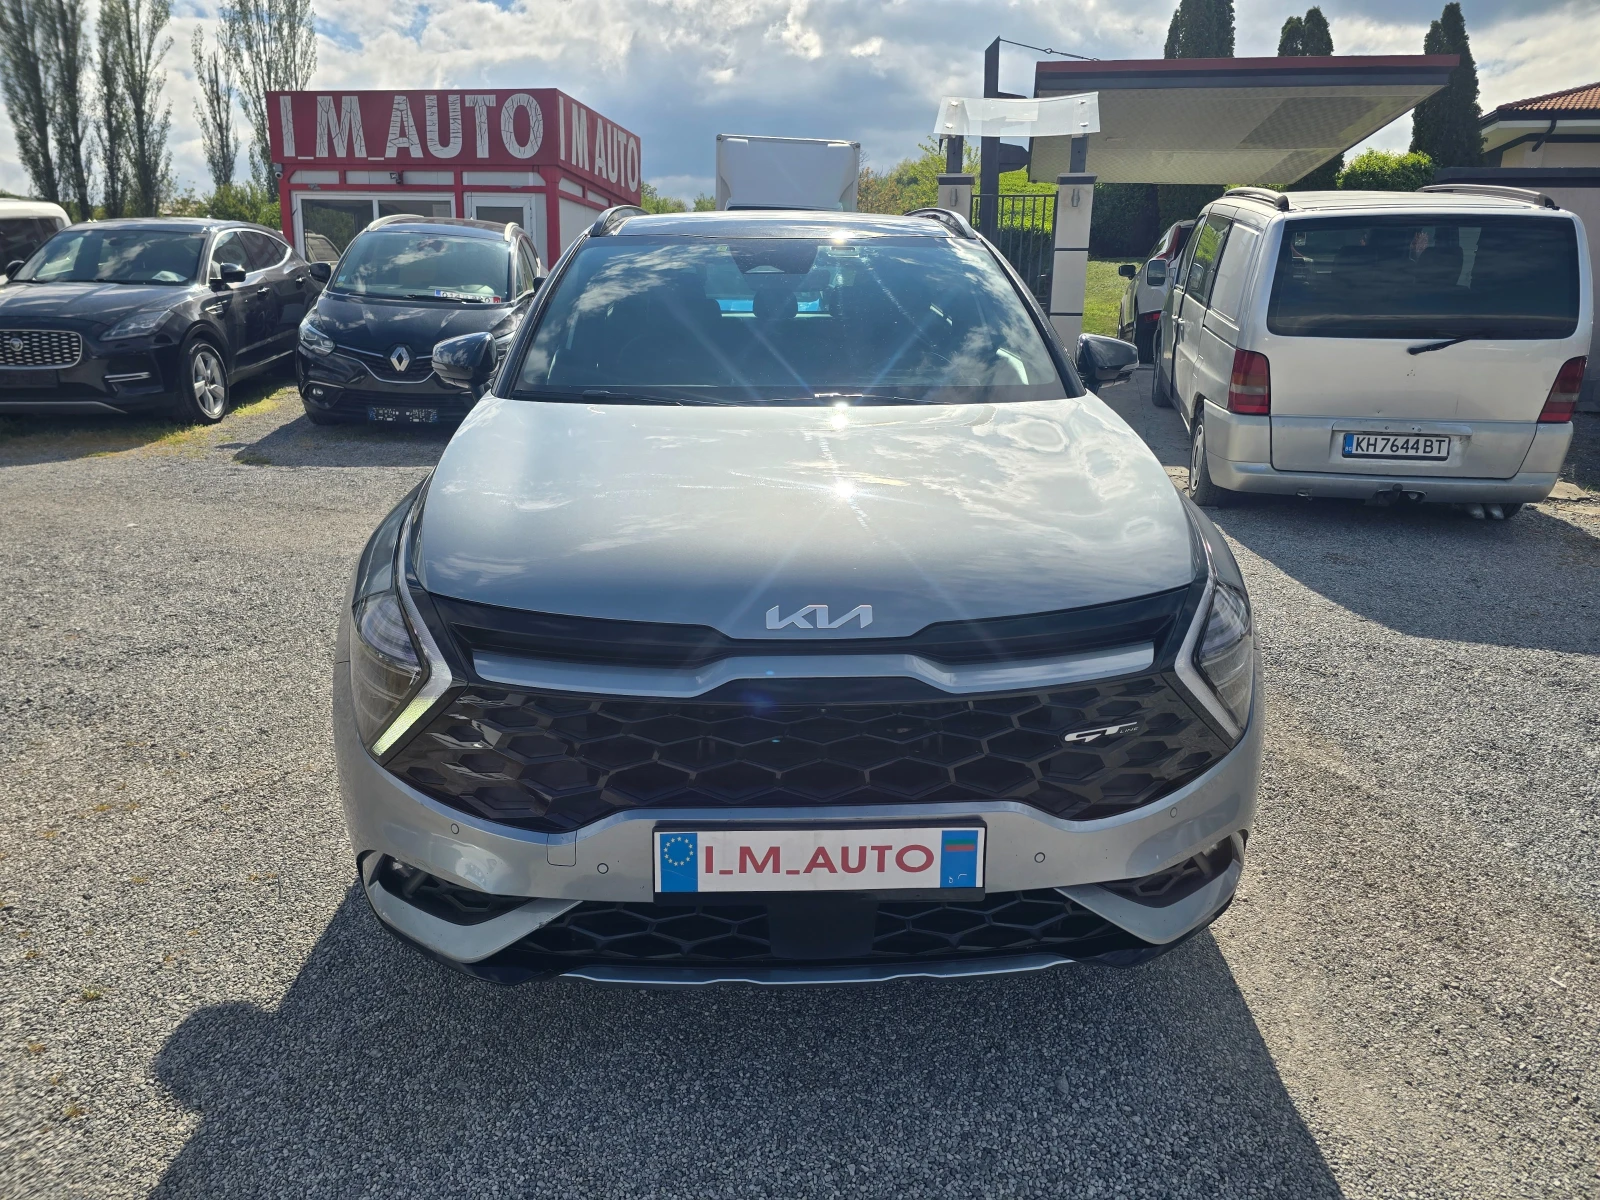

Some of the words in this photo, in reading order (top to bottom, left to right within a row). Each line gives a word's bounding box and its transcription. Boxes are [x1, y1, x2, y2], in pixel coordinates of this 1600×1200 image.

[558, 95, 566, 160] I
[571, 102, 590, 171] M
[594, 118, 638, 193] AUTO
[766, 604, 873, 629] KIA
[704, 844, 935, 875] I_M_AUTO
